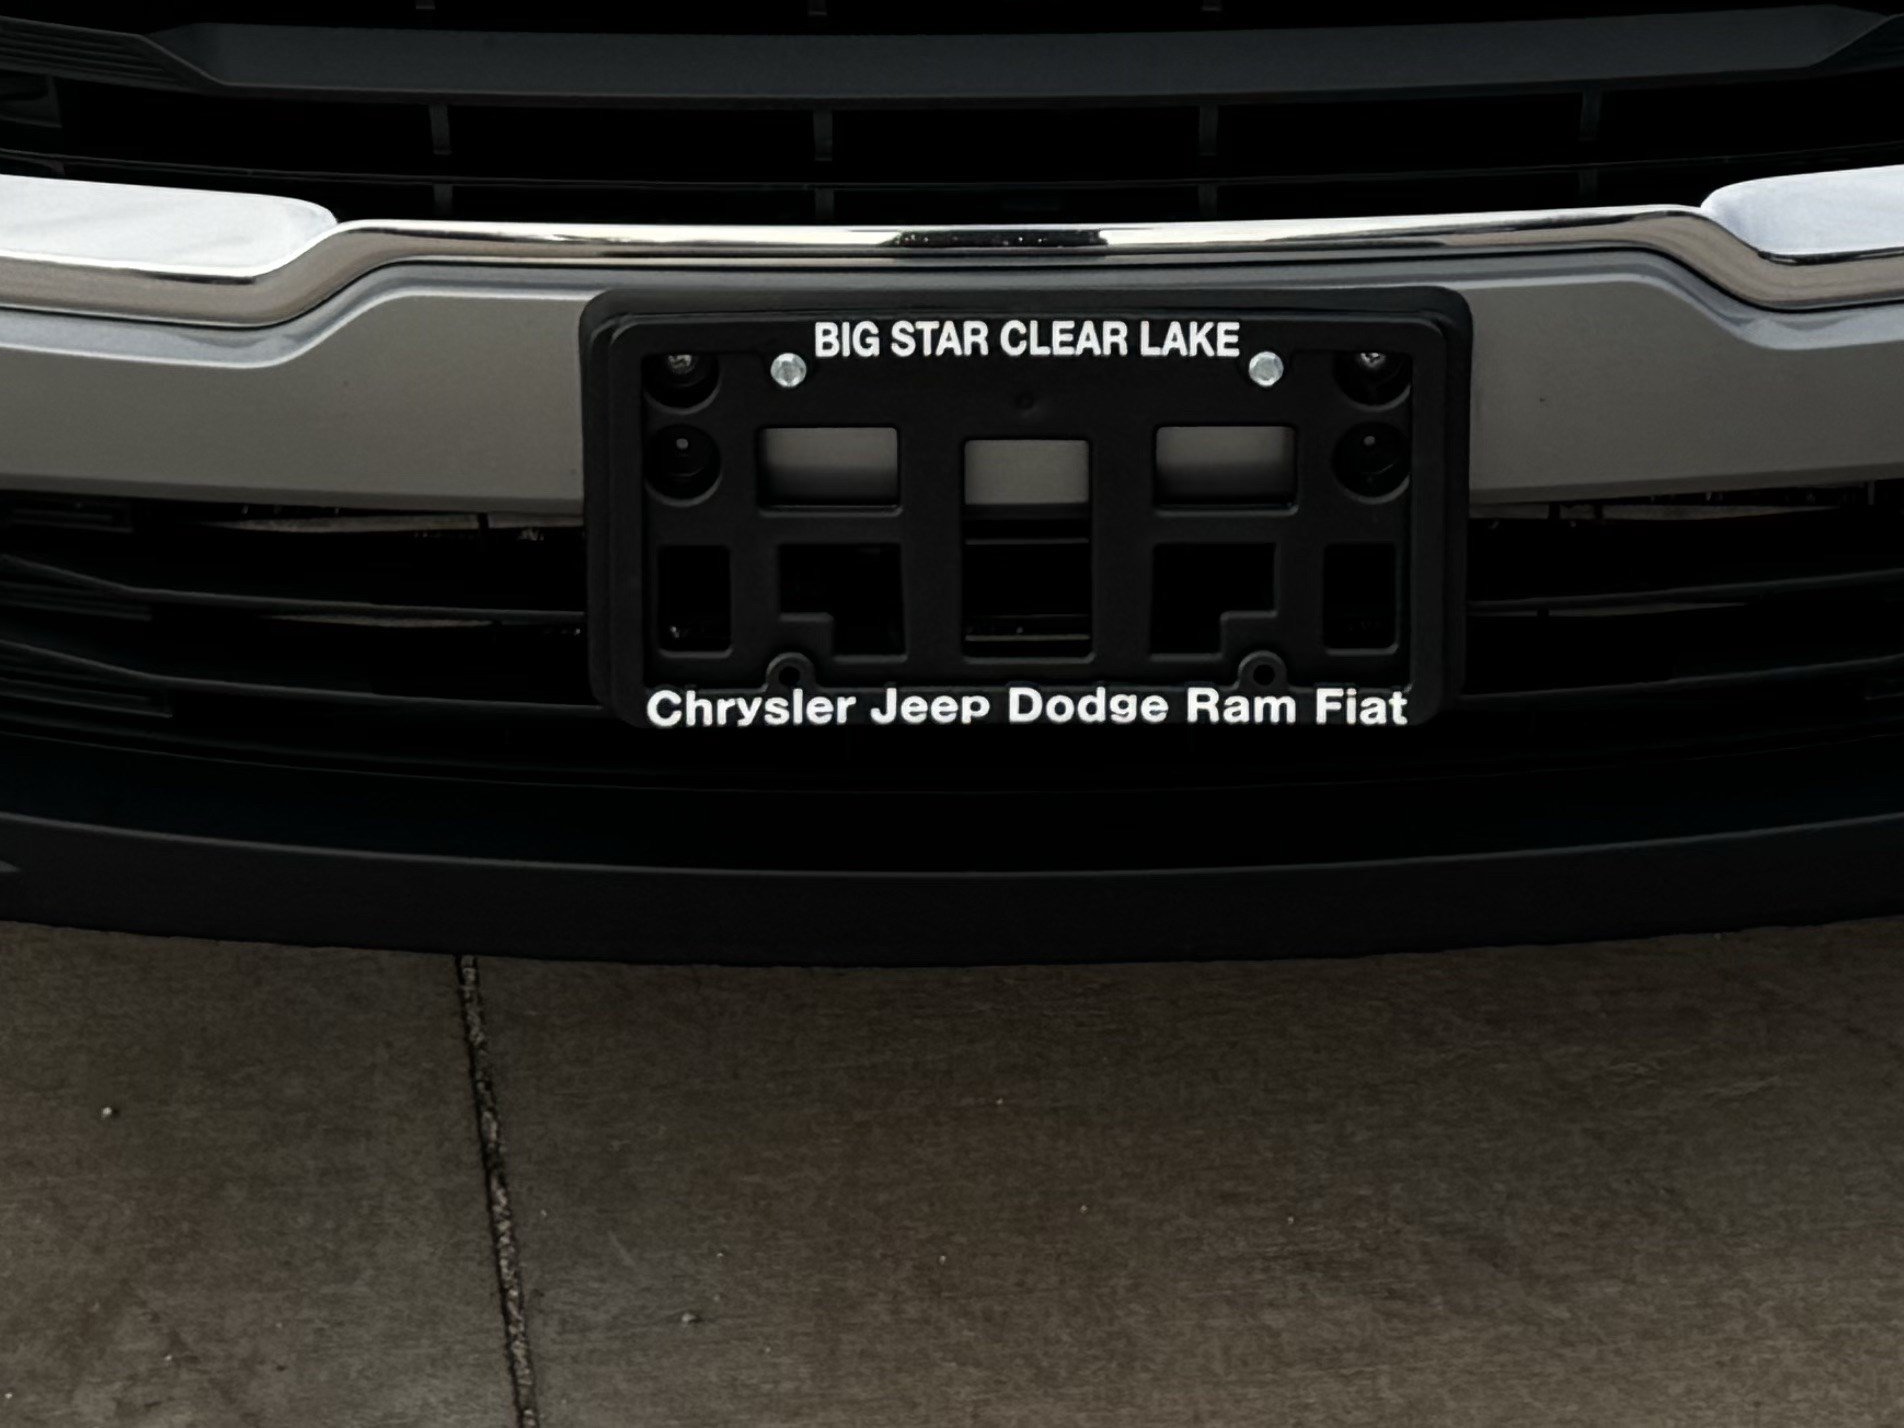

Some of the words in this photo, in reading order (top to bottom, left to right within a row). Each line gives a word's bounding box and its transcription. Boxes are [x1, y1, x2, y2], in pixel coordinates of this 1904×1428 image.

[813, 320, 880, 358] BIG
[890, 319, 989, 357] STAR
[1000, 320, 1128, 357] CLEAR
[1140, 320, 1241, 357] LAKE
[646, 688, 857, 728] Chrysler
[870, 687, 991, 725] Jeep
[1008, 686, 1169, 724] Dodge
[1187, 686, 1296, 724] Ram
[1316, 687, 1409, 726] Fiat
